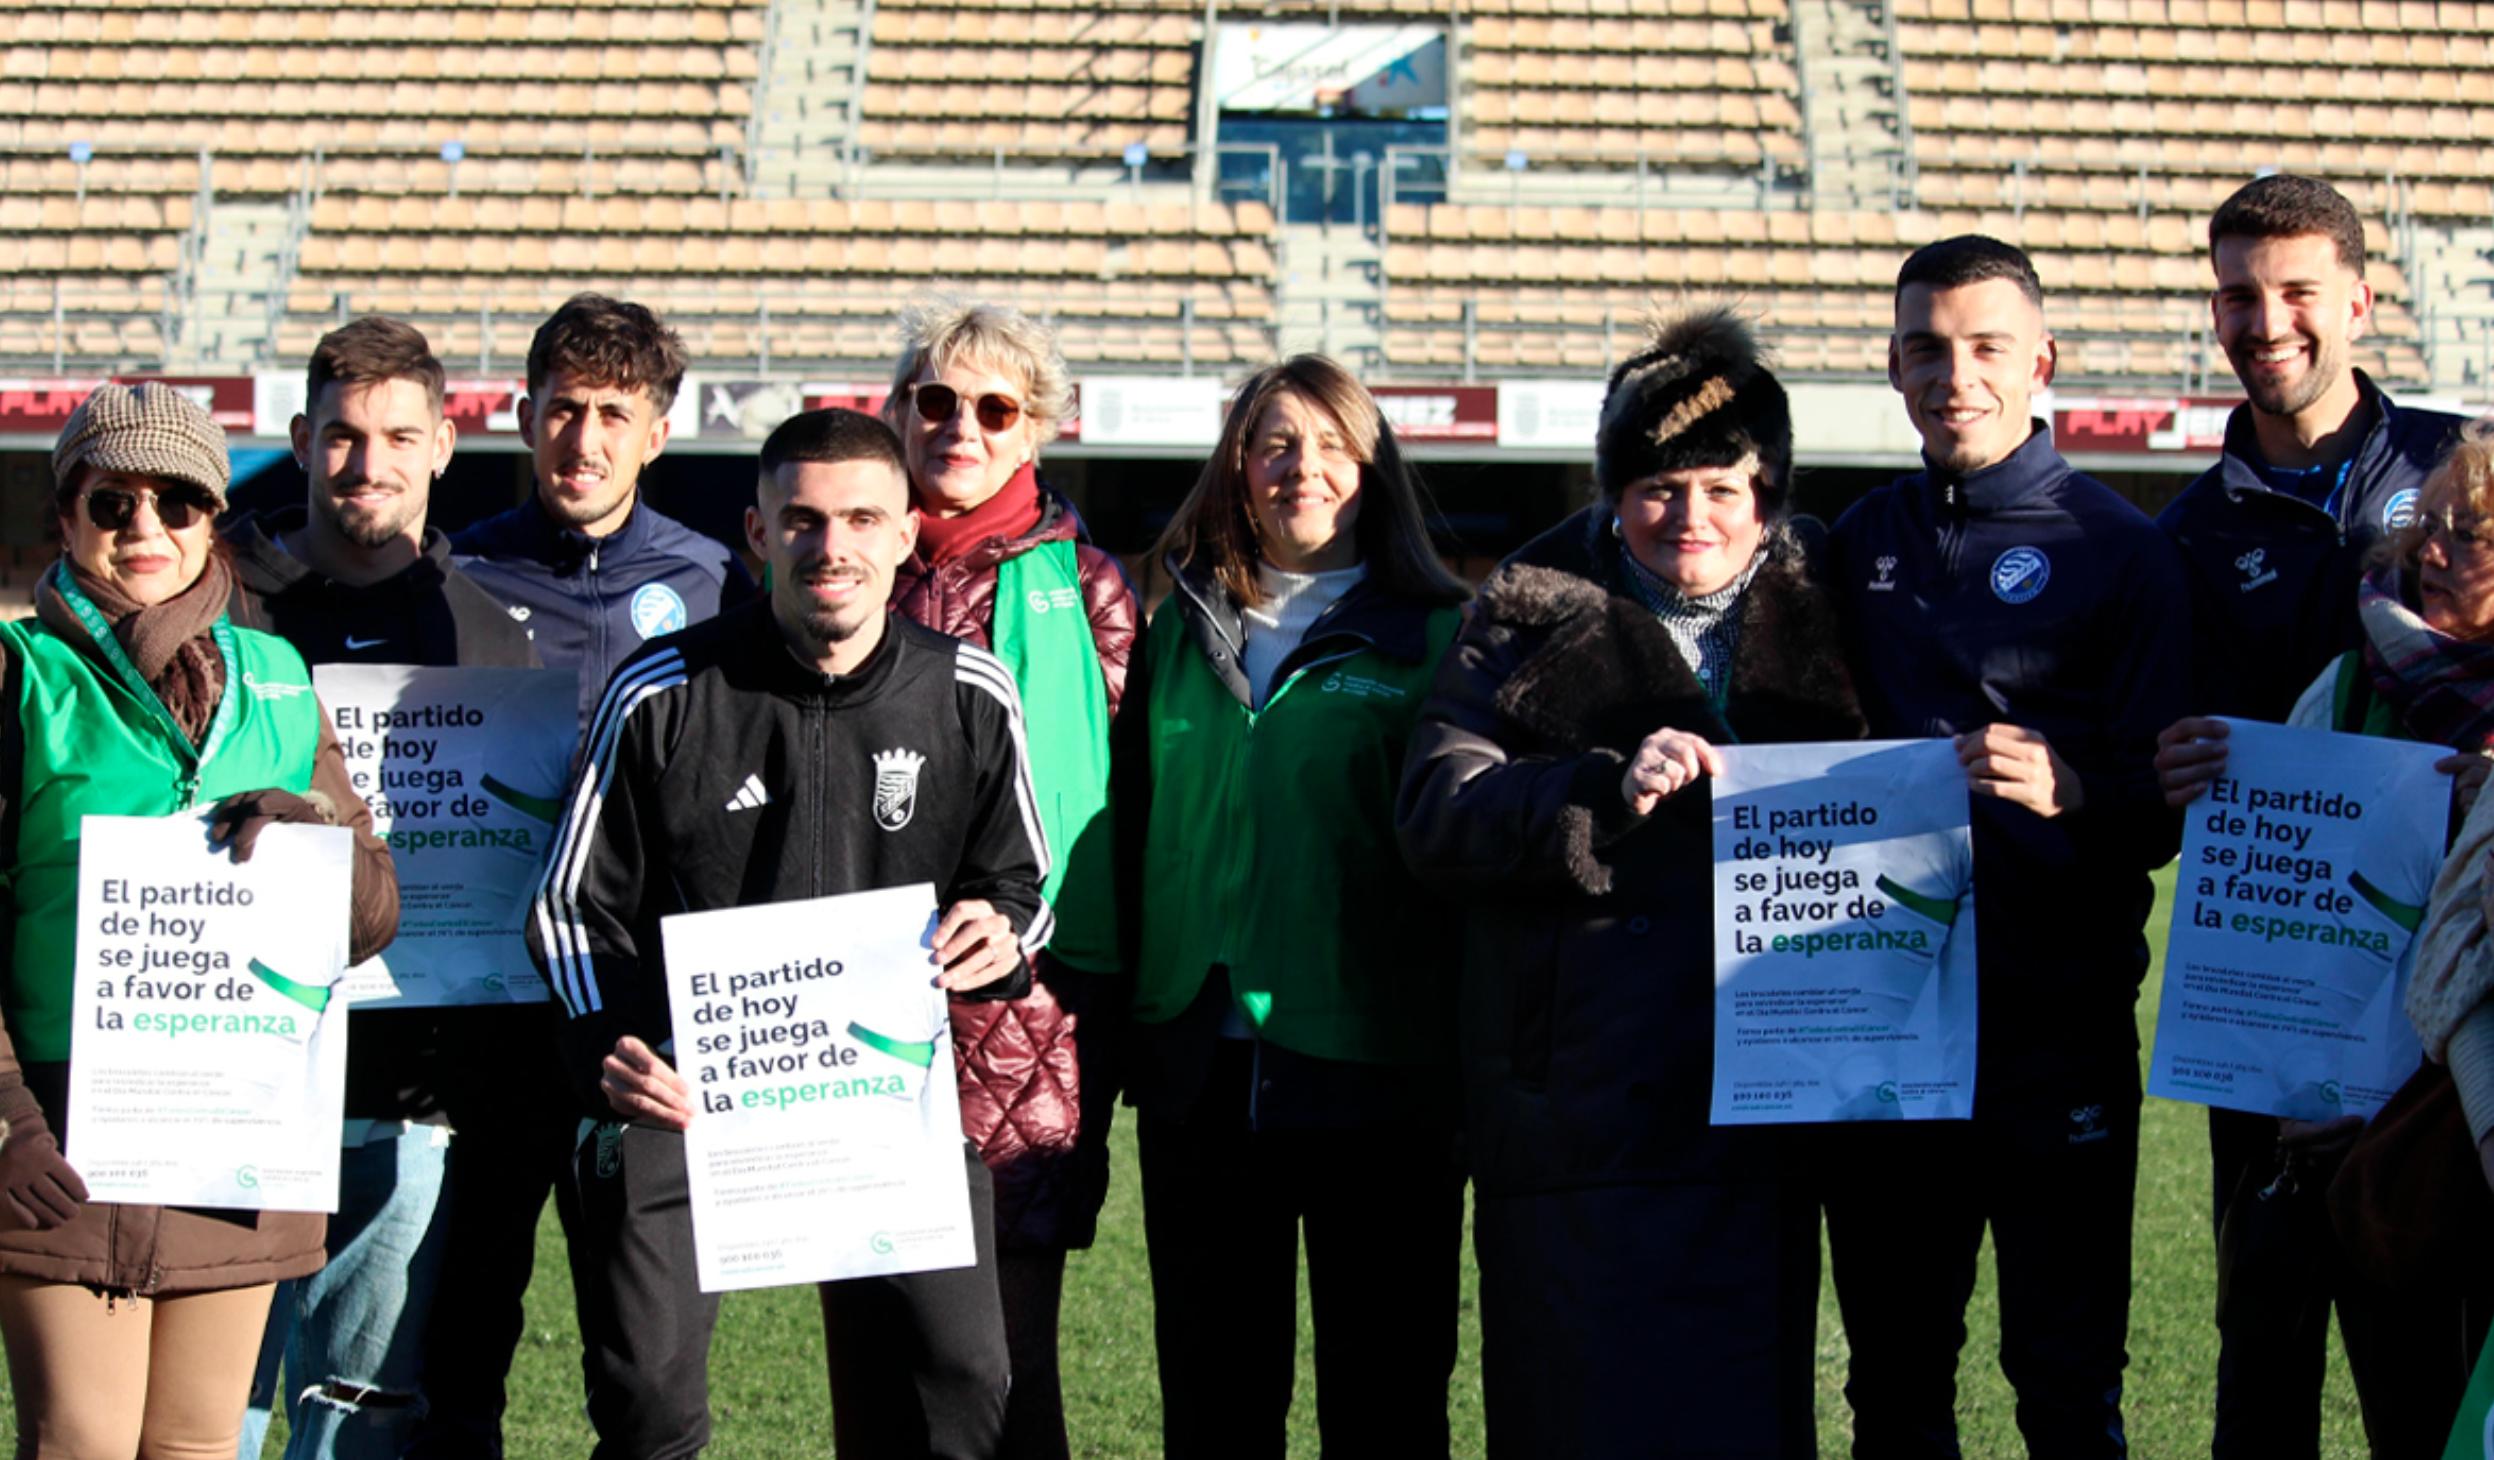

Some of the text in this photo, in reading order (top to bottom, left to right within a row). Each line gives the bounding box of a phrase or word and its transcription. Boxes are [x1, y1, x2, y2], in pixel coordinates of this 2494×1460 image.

[335, 705, 484, 734] El partido
[383, 737, 437, 764] hoy
[352, 765, 464, 794] e juega
[450, 794, 489, 817] de
[2211, 778, 2362, 820] El partido
[1733, 802, 1877, 836] El partido
[2206, 809, 2312, 850] de hoy
[1733, 836, 1833, 865] de hoy
[2202, 845, 2331, 883] se juega
[102, 879, 254, 910] El partido
[1735, 866, 1859, 896] se juega
[2197, 874, 2353, 914] a favor de
[1735, 895, 1885, 923] a favor de
[100, 911, 205, 944] de hoy
[2194, 901, 2389, 951] la esperanza
[1735, 929, 1928, 958] la esperanza
[99, 944, 230, 976] se juega
[96, 975, 254, 1001] a favor de
[690, 957, 844, 997] El partido
[96, 1005, 297, 1038] la esperanza
[693, 994, 798, 1025] de hoy
[696, 1019, 829, 1055] se juega
[700, 1044, 858, 1084] a favor de
[703, 1074, 906, 1114] la esperanza
